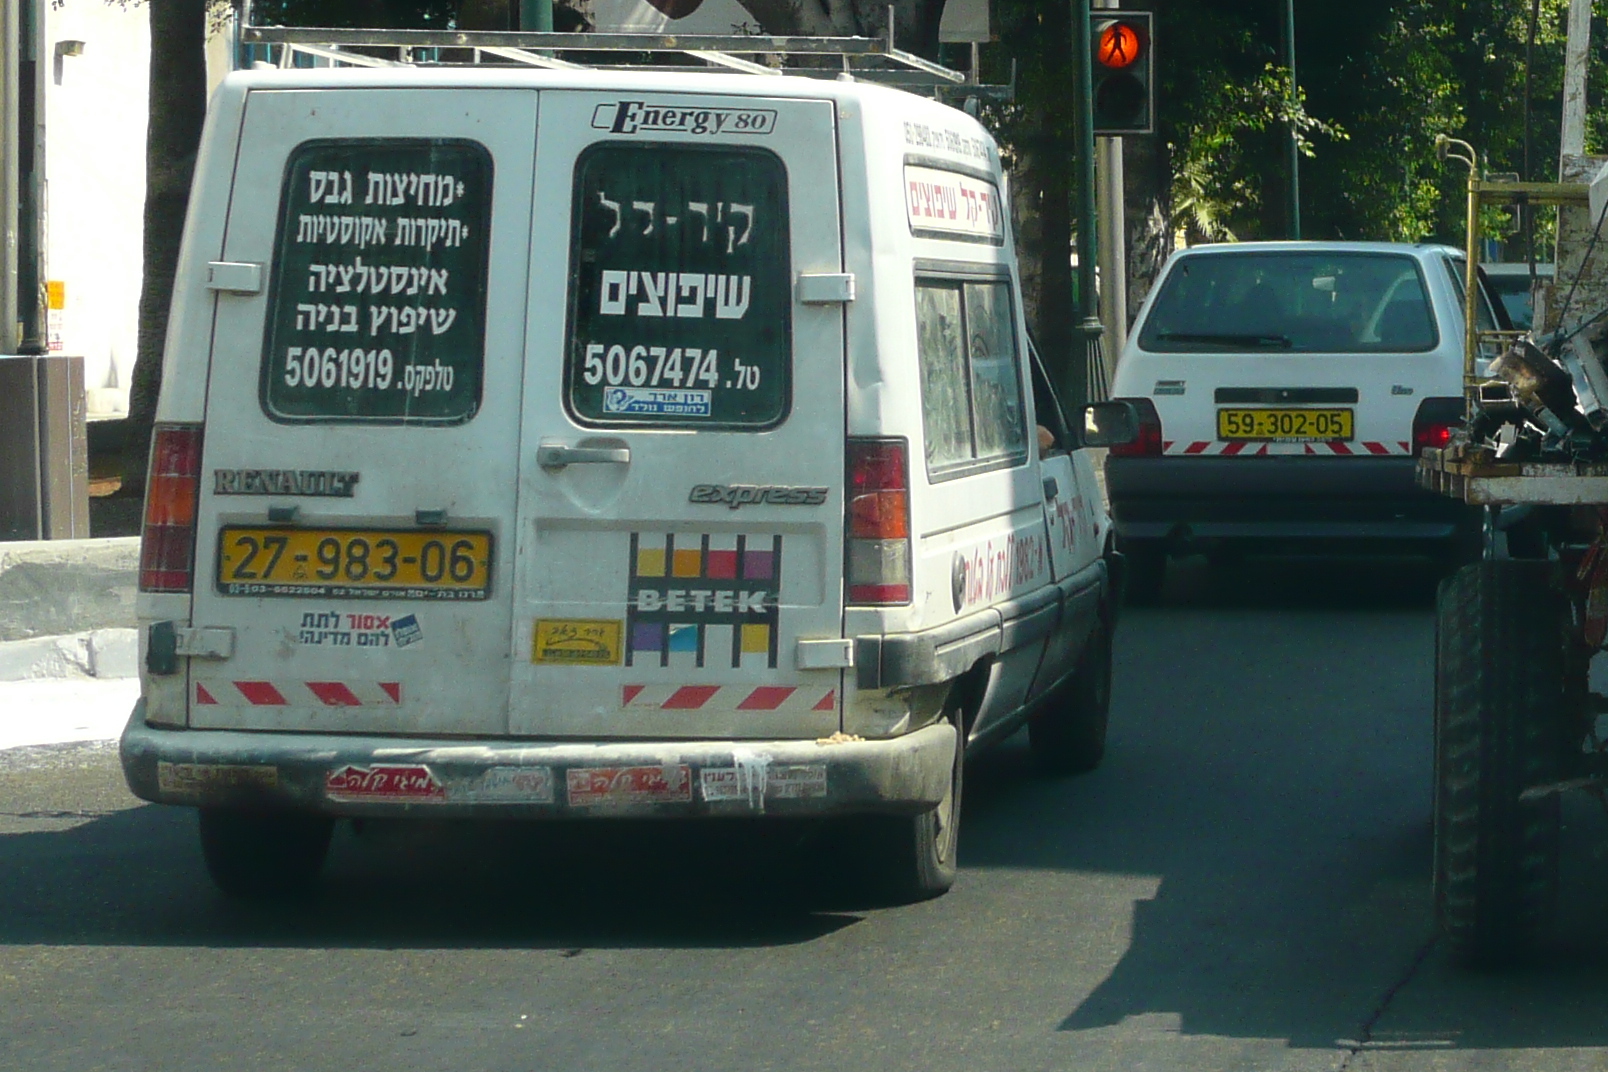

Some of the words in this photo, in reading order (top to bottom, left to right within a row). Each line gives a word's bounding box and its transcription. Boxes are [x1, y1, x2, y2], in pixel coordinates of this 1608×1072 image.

[610, 101, 731, 134] Energy
[735, 112, 767, 130] 80
[308, 170, 353, 205] גבס
[908, 181, 957, 221] שיפוצים
[296, 213, 388, 249] אקוסטיות
[307, 256, 449, 296] אינסטלציה
[600, 269, 751, 319] שיפוצים
[295, 303, 359, 332] בניה
[369, 305, 457, 336] שיפוץ
[284, 346, 395, 390] 5061919
[583, 343, 719, 389] 5067474
[1227, 413, 1343, 435] 59-302-05
[213, 468, 360, 497] RENAULT
[688, 483, 829, 510] express
[231, 535, 475, 583] 27-983-06
[637, 588, 770, 613] BETEK
[300, 610, 340, 629] לתת
[347, 614, 391, 631] אסור
[356, 630, 390, 647] להם
